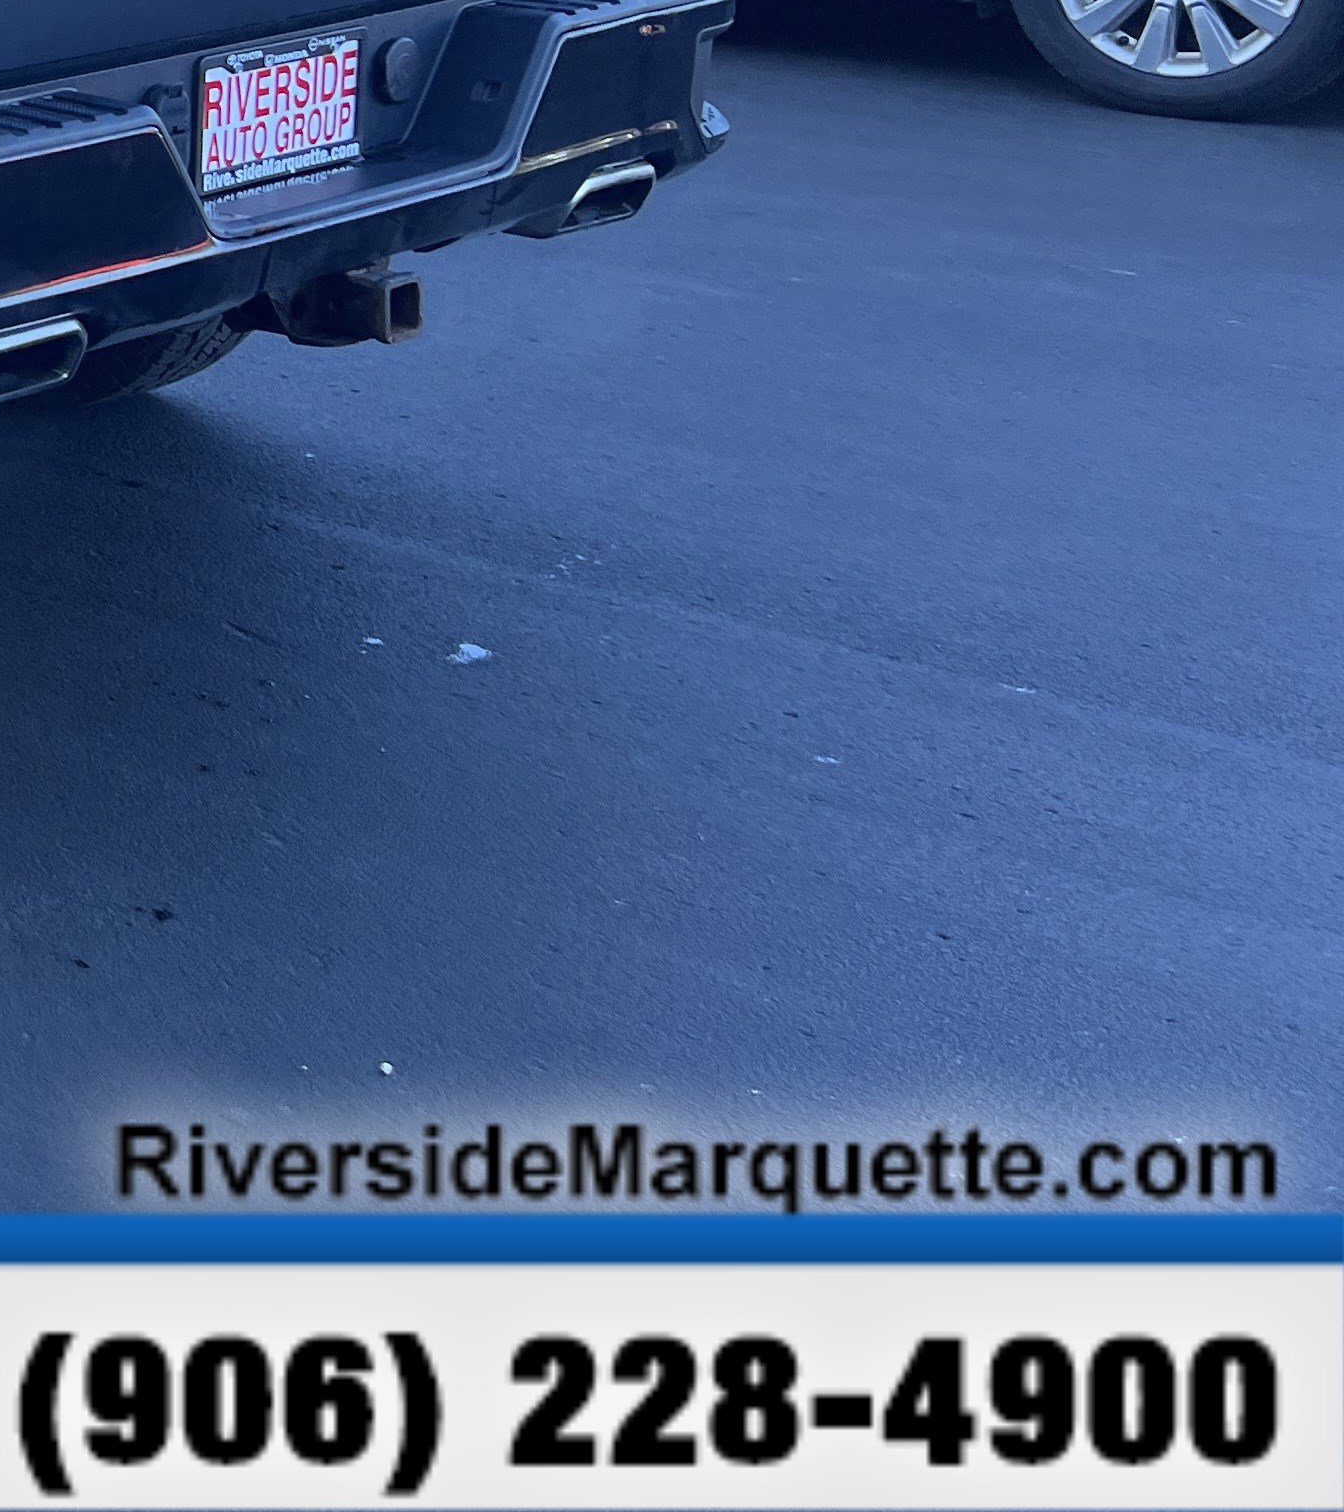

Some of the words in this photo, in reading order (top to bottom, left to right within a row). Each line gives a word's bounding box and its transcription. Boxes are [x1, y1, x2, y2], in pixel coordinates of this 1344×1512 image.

[204, 49, 358, 130] RIVERSIDE
[206, 121, 268, 172] AUTO
[274, 102, 351, 153] GROUP
